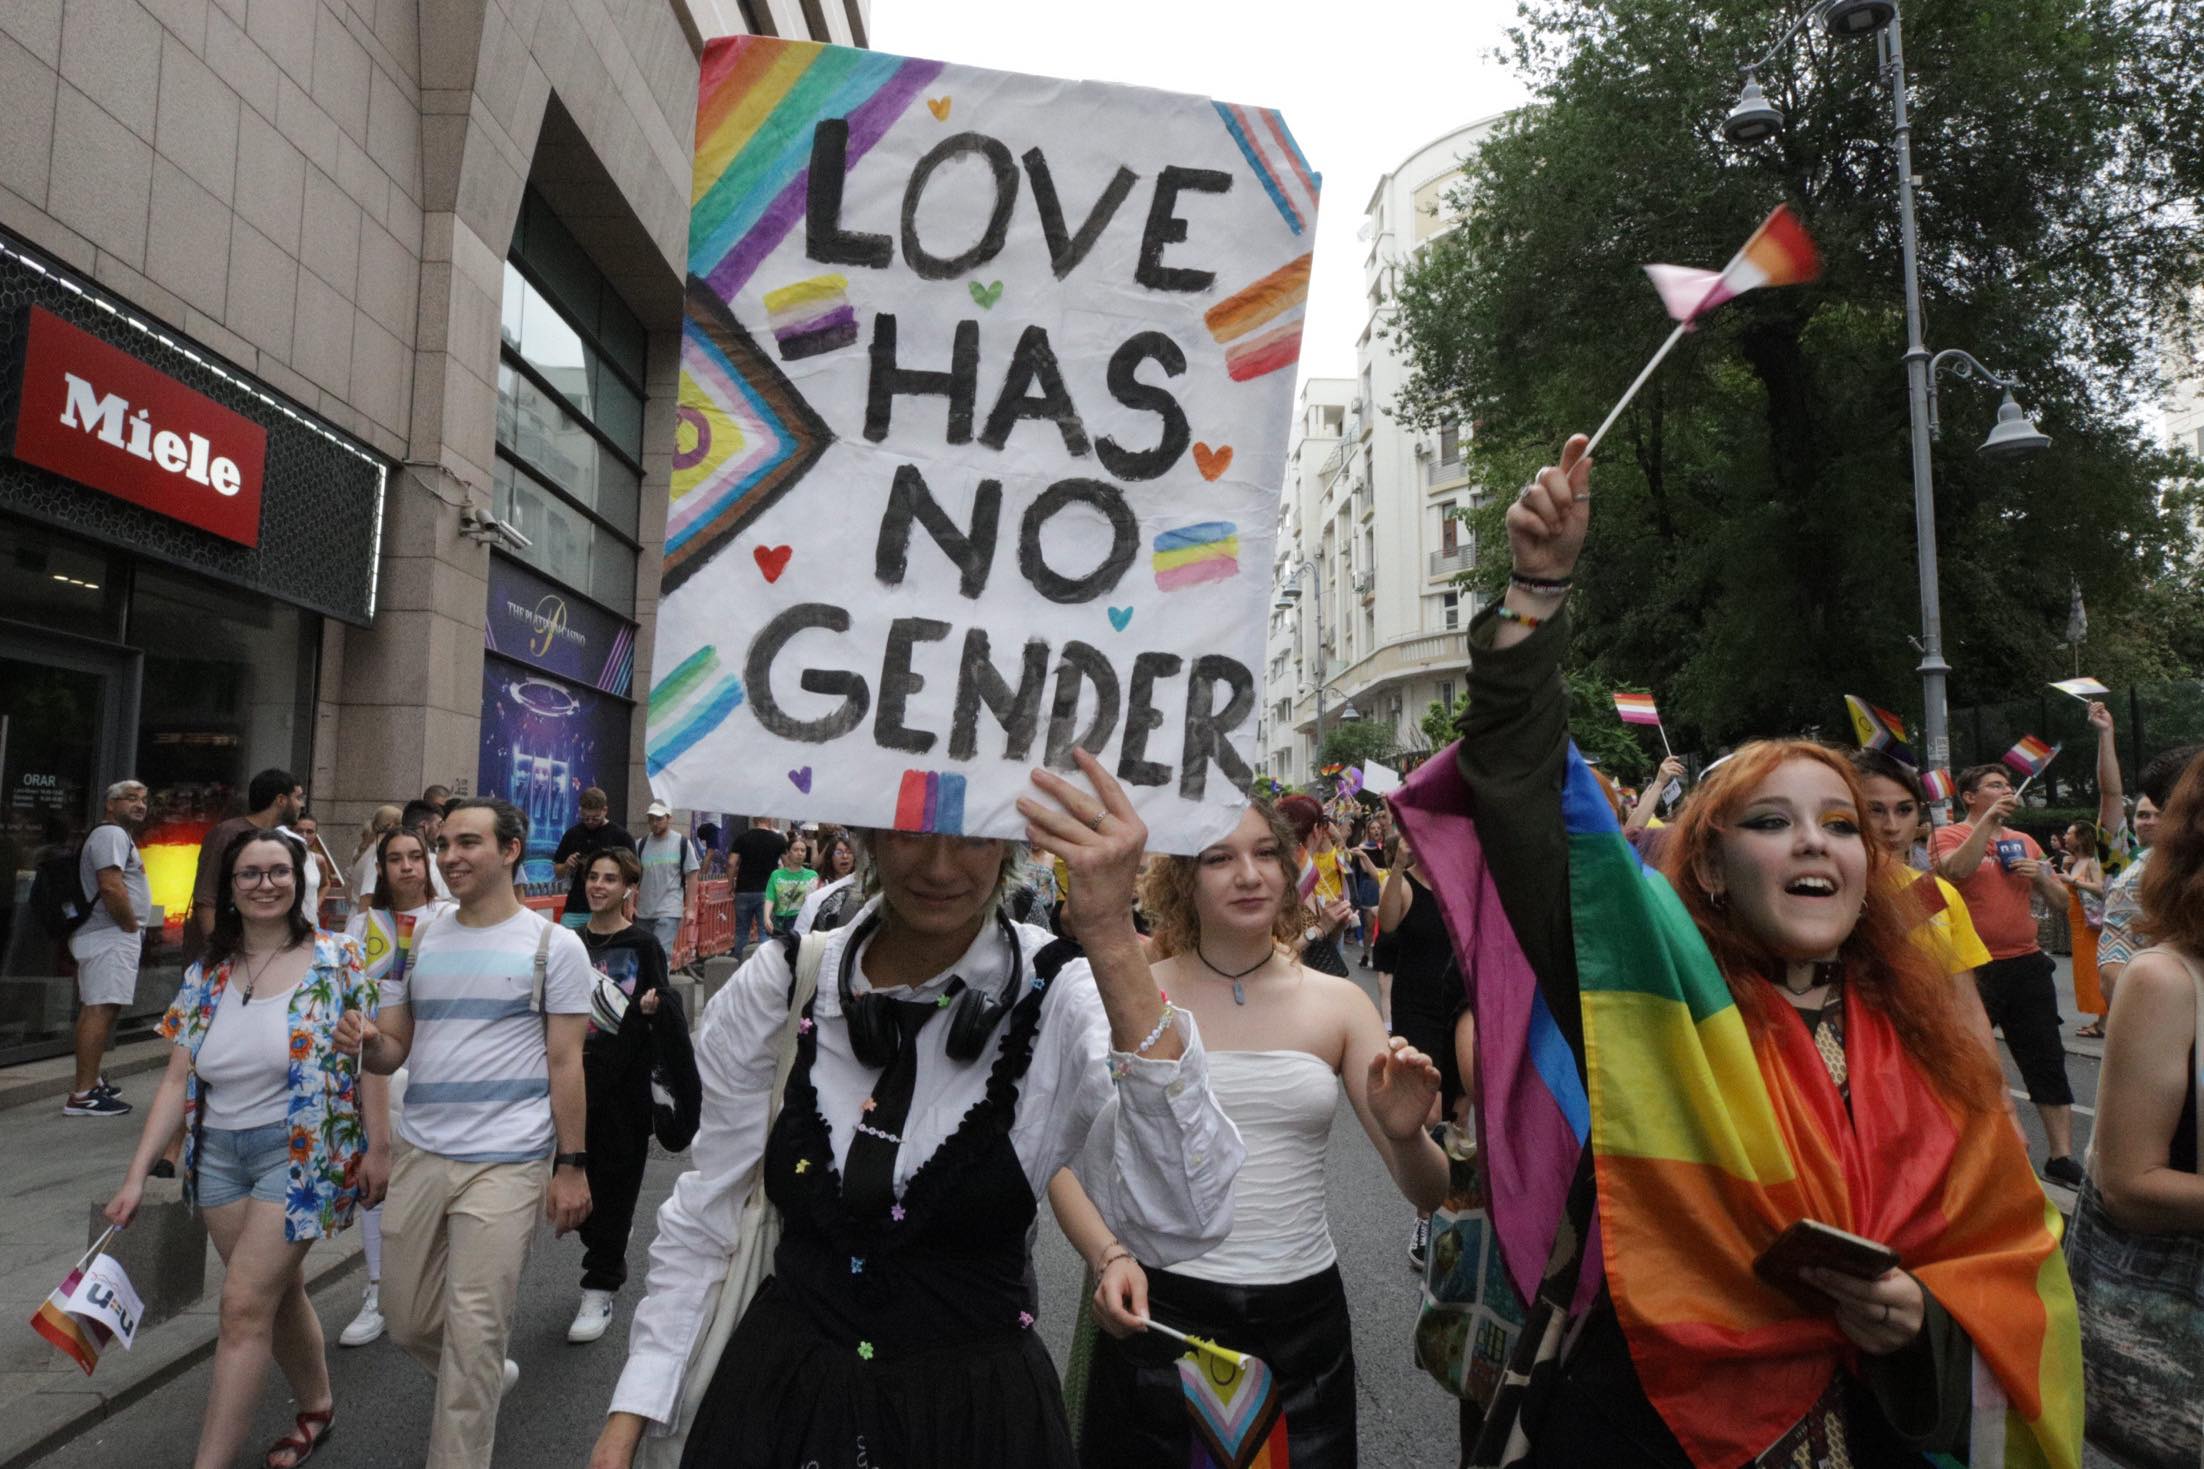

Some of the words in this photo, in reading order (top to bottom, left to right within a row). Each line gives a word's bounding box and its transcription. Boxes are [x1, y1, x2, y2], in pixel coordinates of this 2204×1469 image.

[805, 118, 1233, 291] LOVE
[60, 372, 241, 496] Miele
[863, 313, 1191, 481] HAS
[875, 464, 1141, 603] NO
[507, 601, 524, 617] THE
[743, 602, 1255, 799] GENDER
[23, 773, 56, 786] ORAR
